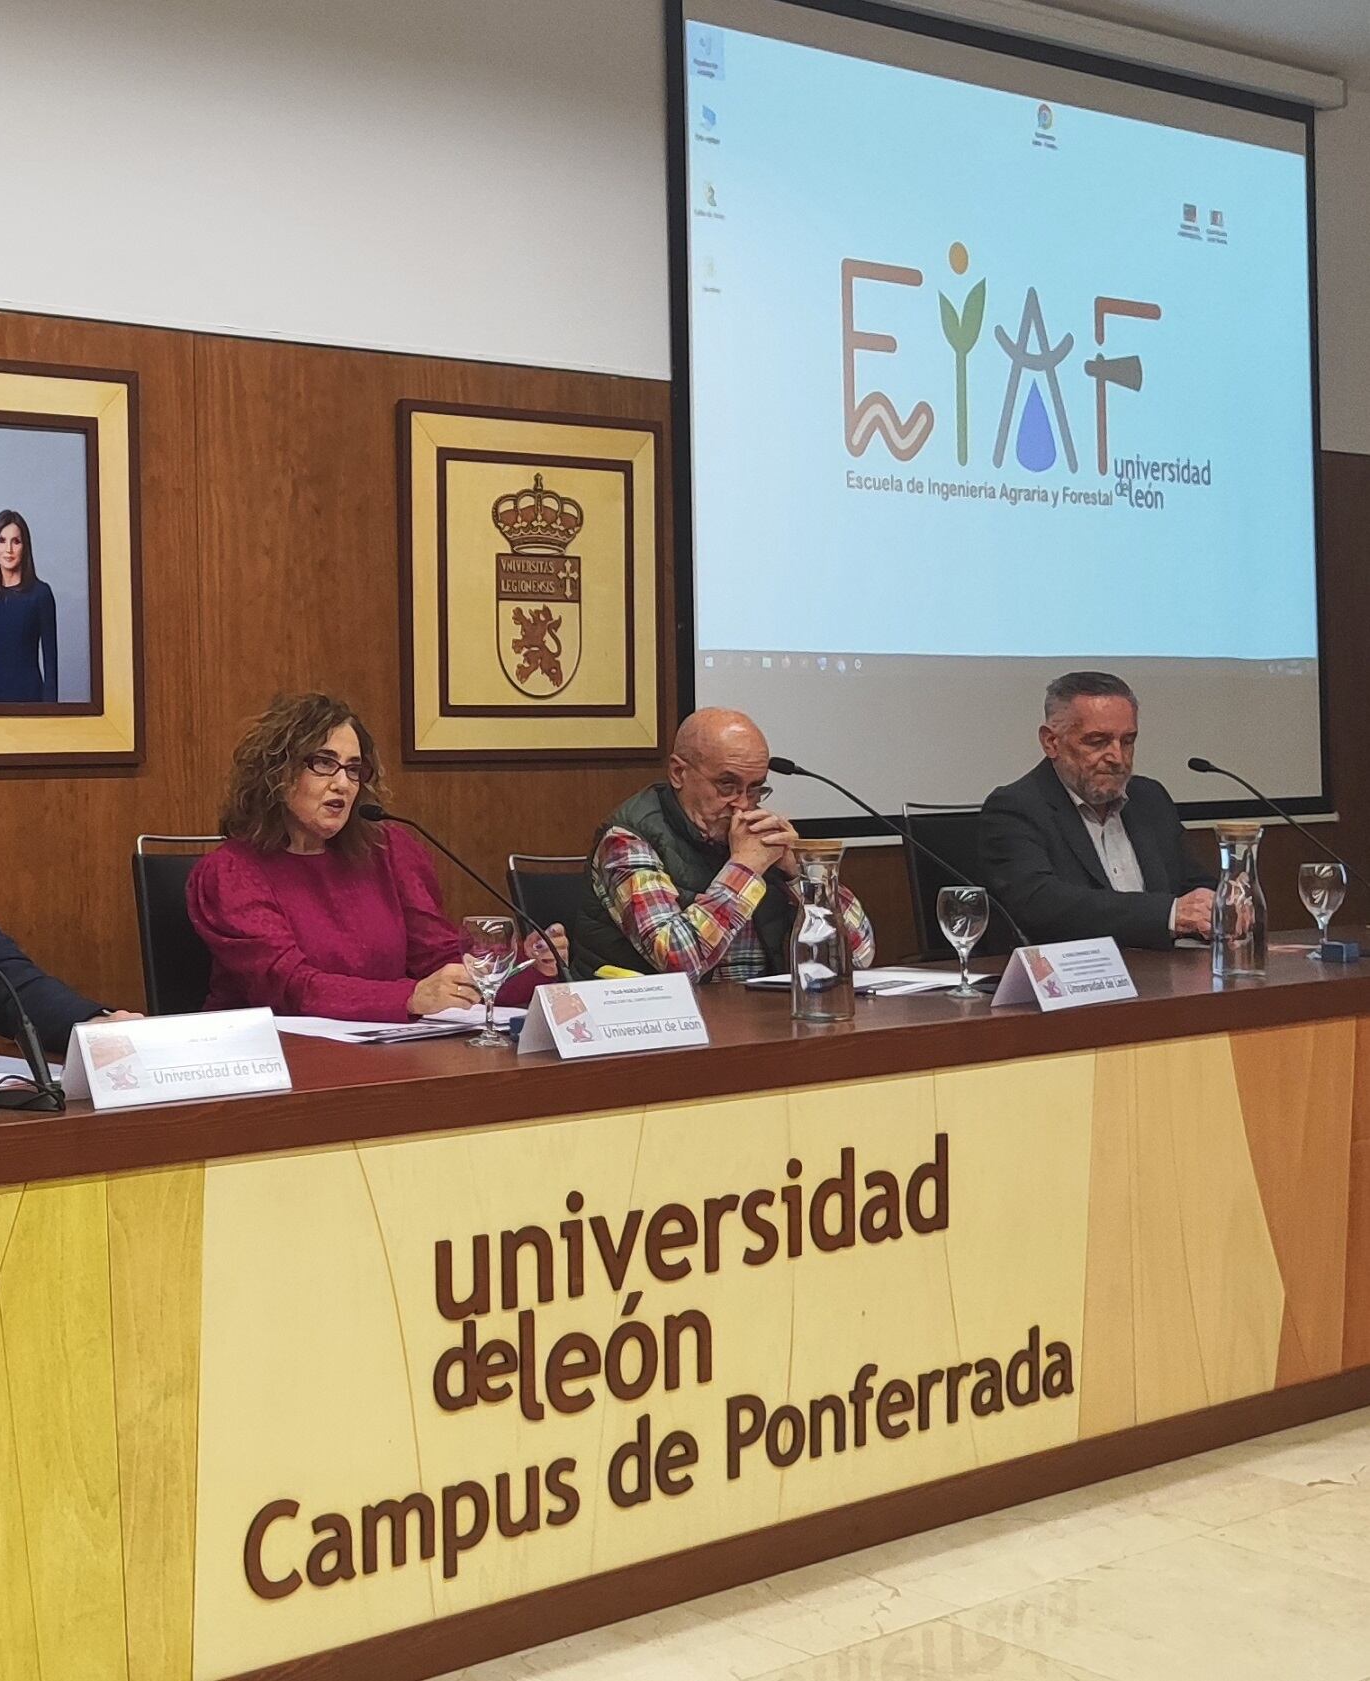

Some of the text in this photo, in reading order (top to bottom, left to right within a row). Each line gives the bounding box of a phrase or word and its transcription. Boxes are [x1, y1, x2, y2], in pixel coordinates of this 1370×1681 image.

[1114, 454, 1212, 486] universidad
[846, 470, 904, 493] Escuela
[906, 475, 925, 495] de
[999, 482, 1049, 506] Agraria
[1051, 489, 1060, 508] y
[1062, 486, 1114, 506] Forestal
[1114, 480, 1165, 510] de león
[501, 559, 554, 573] VNIVERSITAS
[501, 580, 555, 593] LEGIONENSIS
[604, 1017, 701, 1039] Universidad de León
[154, 1058, 282, 1084] Universidad de León
[434, 1132, 950, 1321] universidad
[433, 1290, 713, 1420] de león
[243, 1326, 1074, 1600] Campus de Ponferrada
